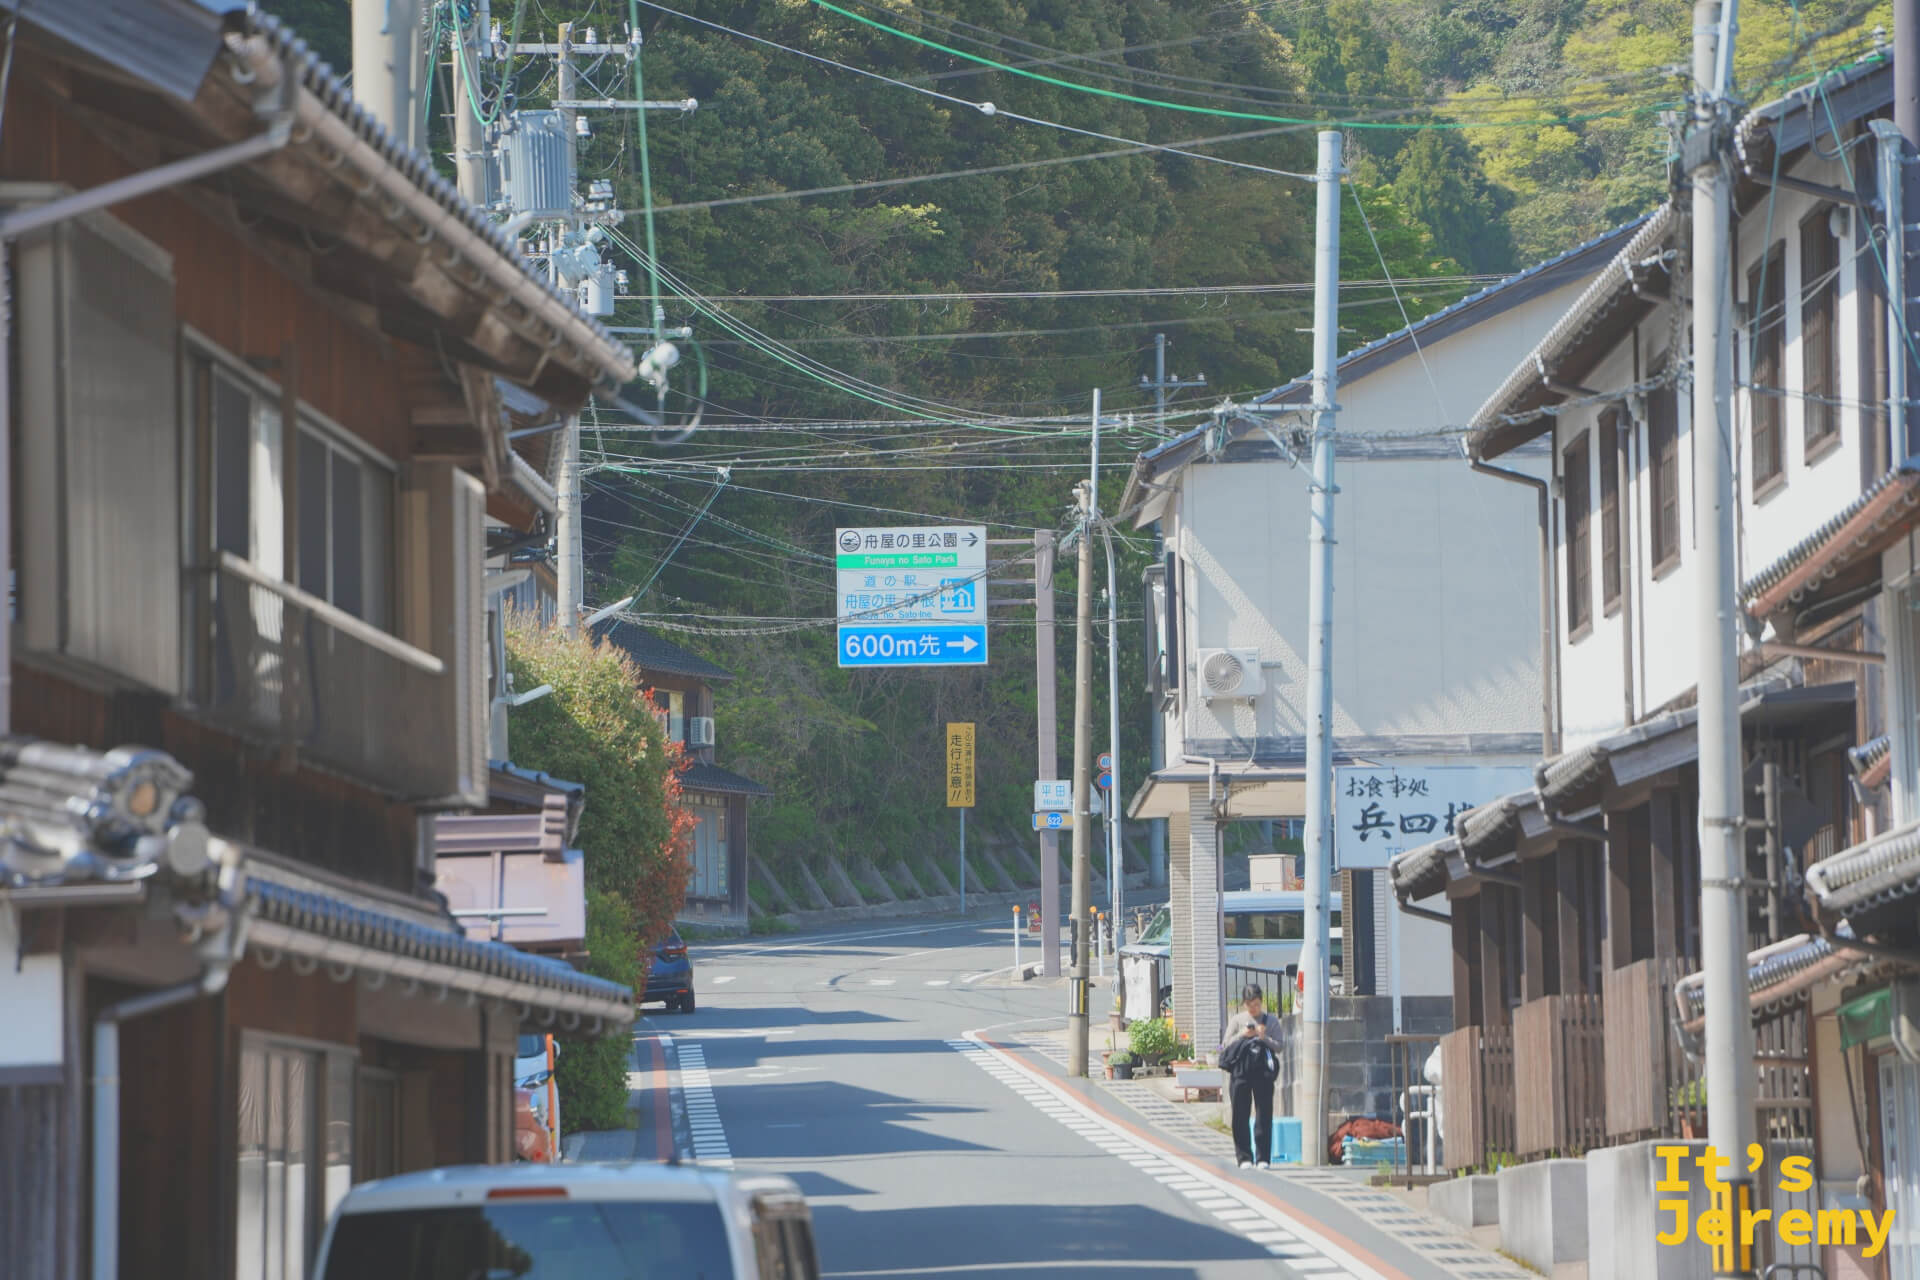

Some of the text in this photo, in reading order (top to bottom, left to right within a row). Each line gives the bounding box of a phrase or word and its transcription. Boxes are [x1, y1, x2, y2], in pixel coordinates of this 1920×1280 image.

[865, 533, 957, 549] 舟屋の里公園
[912, 555, 932, 564] Sato
[935, 554, 955, 563] Park
[864, 575, 917, 587] 道の駅
[845, 634, 940, 657] 600m先
[1041, 784, 1065, 797] 平田
[1345, 775, 1429, 798] お食事処
